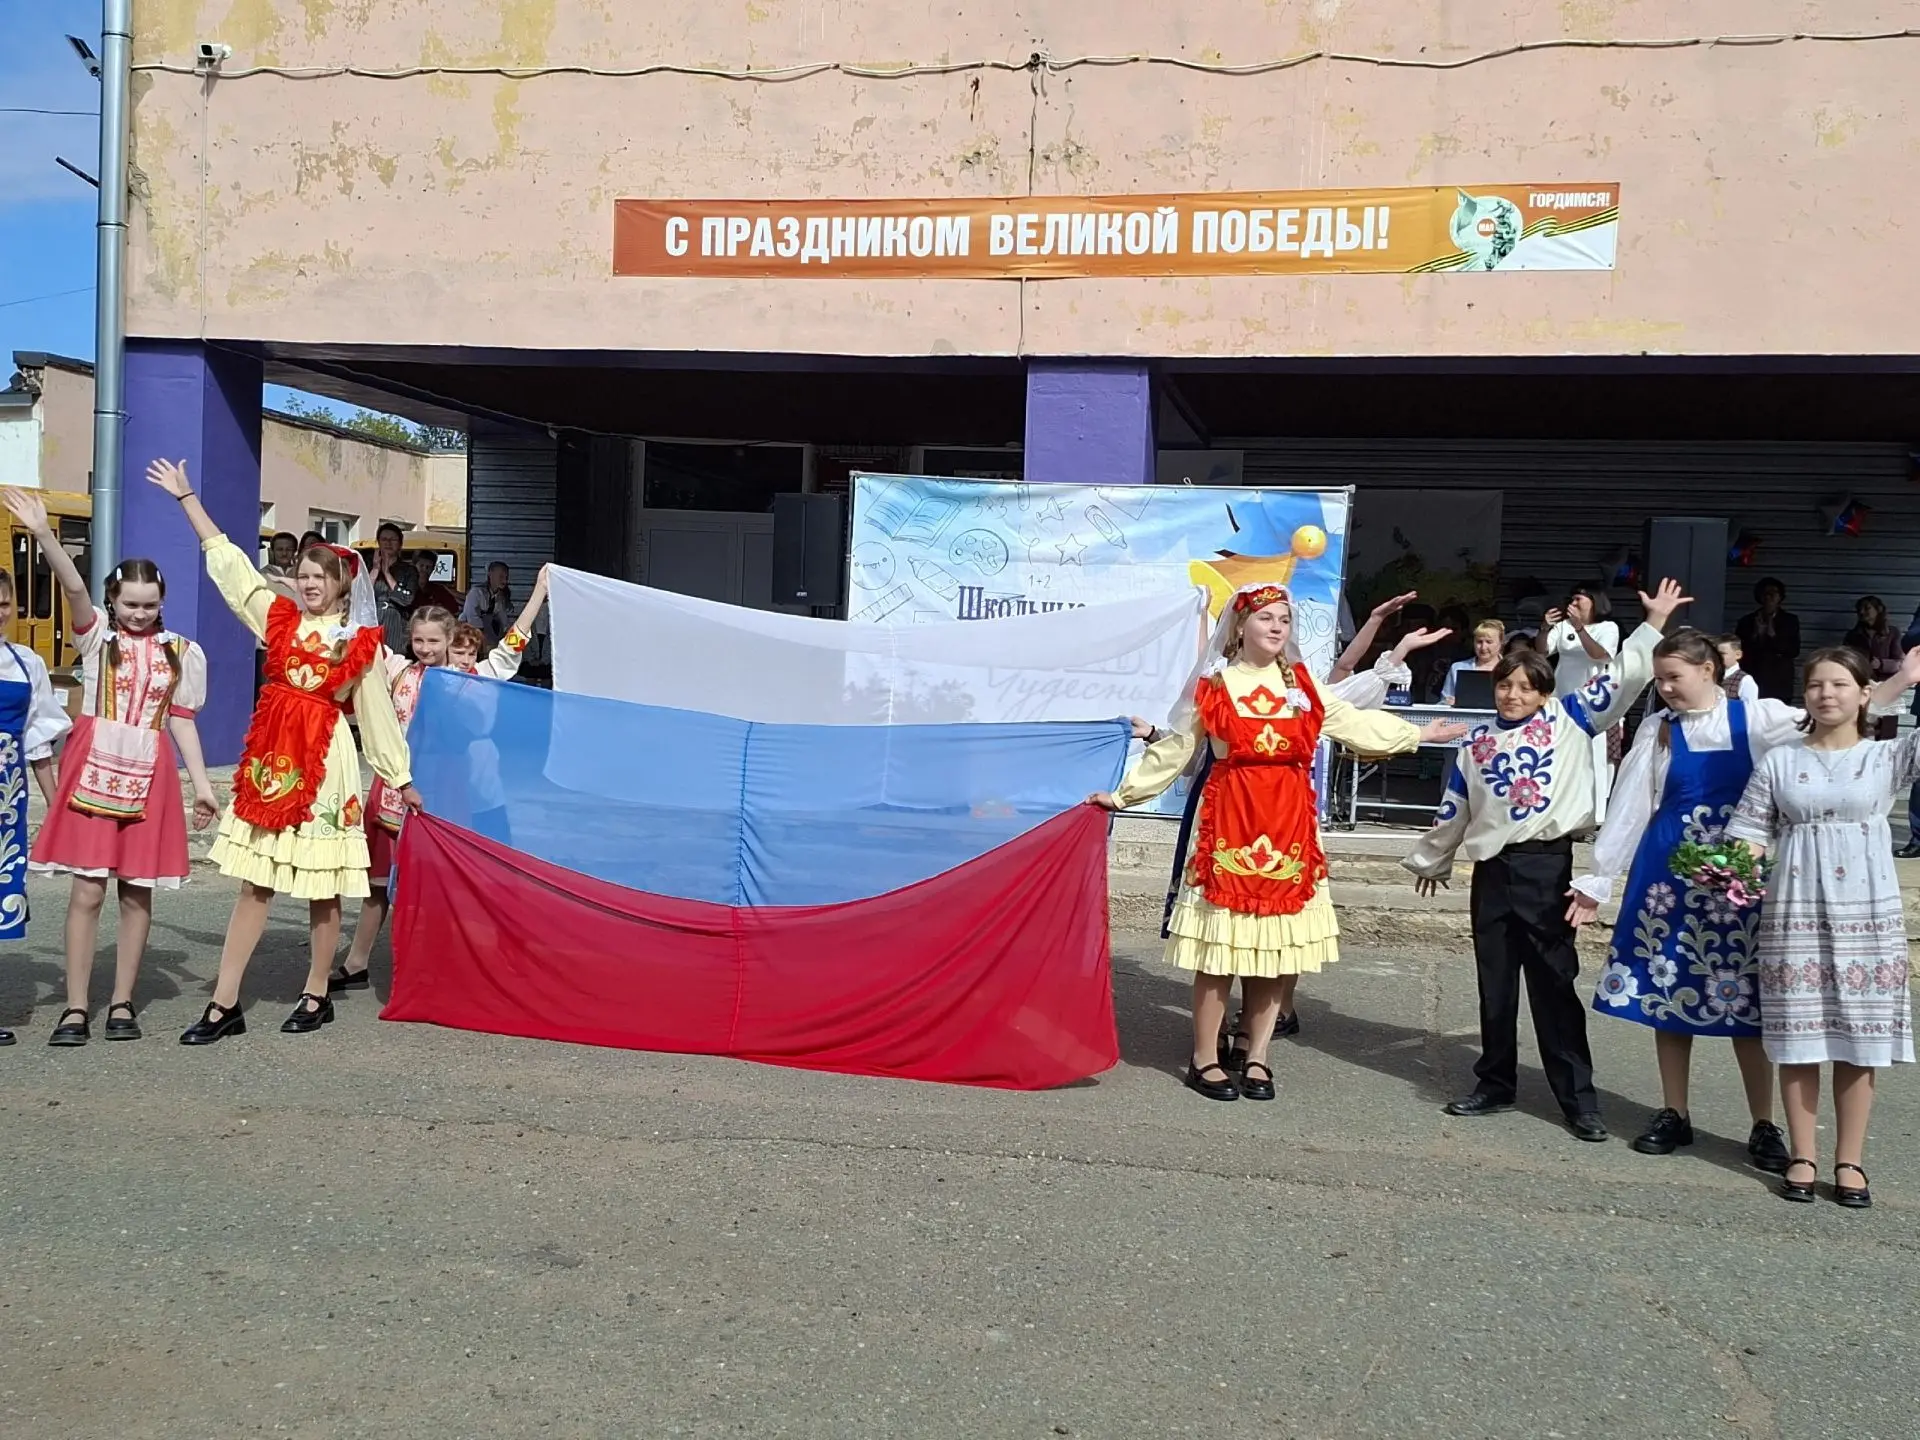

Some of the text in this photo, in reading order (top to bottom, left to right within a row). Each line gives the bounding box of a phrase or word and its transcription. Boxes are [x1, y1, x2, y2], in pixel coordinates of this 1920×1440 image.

[1529, 191, 1610, 210] ГОРДИМСЯ!
[665, 206, 1390, 264] С ПРАЗДНИКОМ ВЕЛИКОЙ ПОБЕДЫ!
